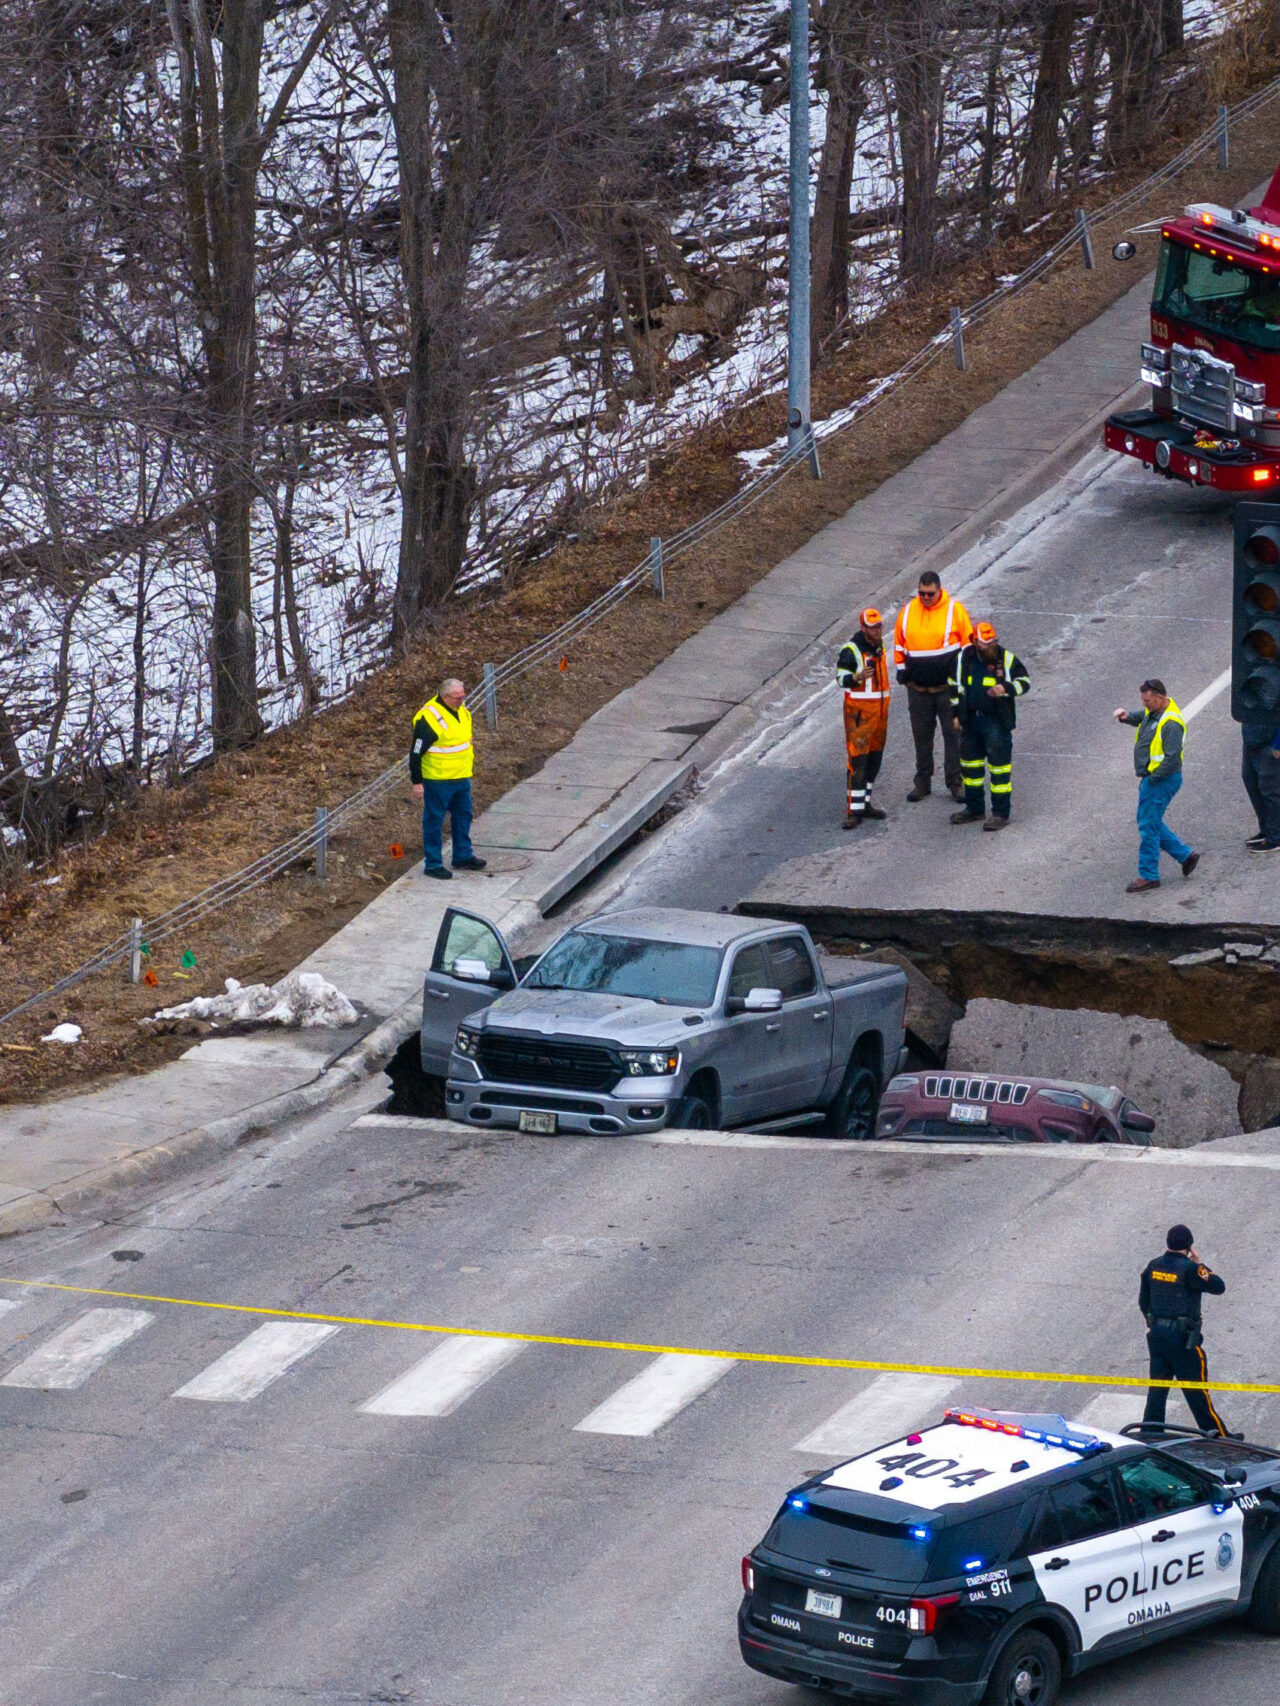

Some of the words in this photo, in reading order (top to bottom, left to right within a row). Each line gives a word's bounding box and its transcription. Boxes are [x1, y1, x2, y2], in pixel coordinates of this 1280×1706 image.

[875, 1452, 996, 1489] 404
[1239, 1493, 1261, 1511] 404
[965, 1568, 1008, 1587] EMERGENCY
[1084, 1550, 1205, 1613] POLICE
[968, 1590, 987, 1602] DIAL
[990, 1578, 1012, 1597] 911
[875, 1606, 906, 1624] 404
[1127, 1601, 1172, 1625] OMAHA
[770, 1614, 801, 1632] OMAHA
[837, 1631, 875, 1648] POLICE
